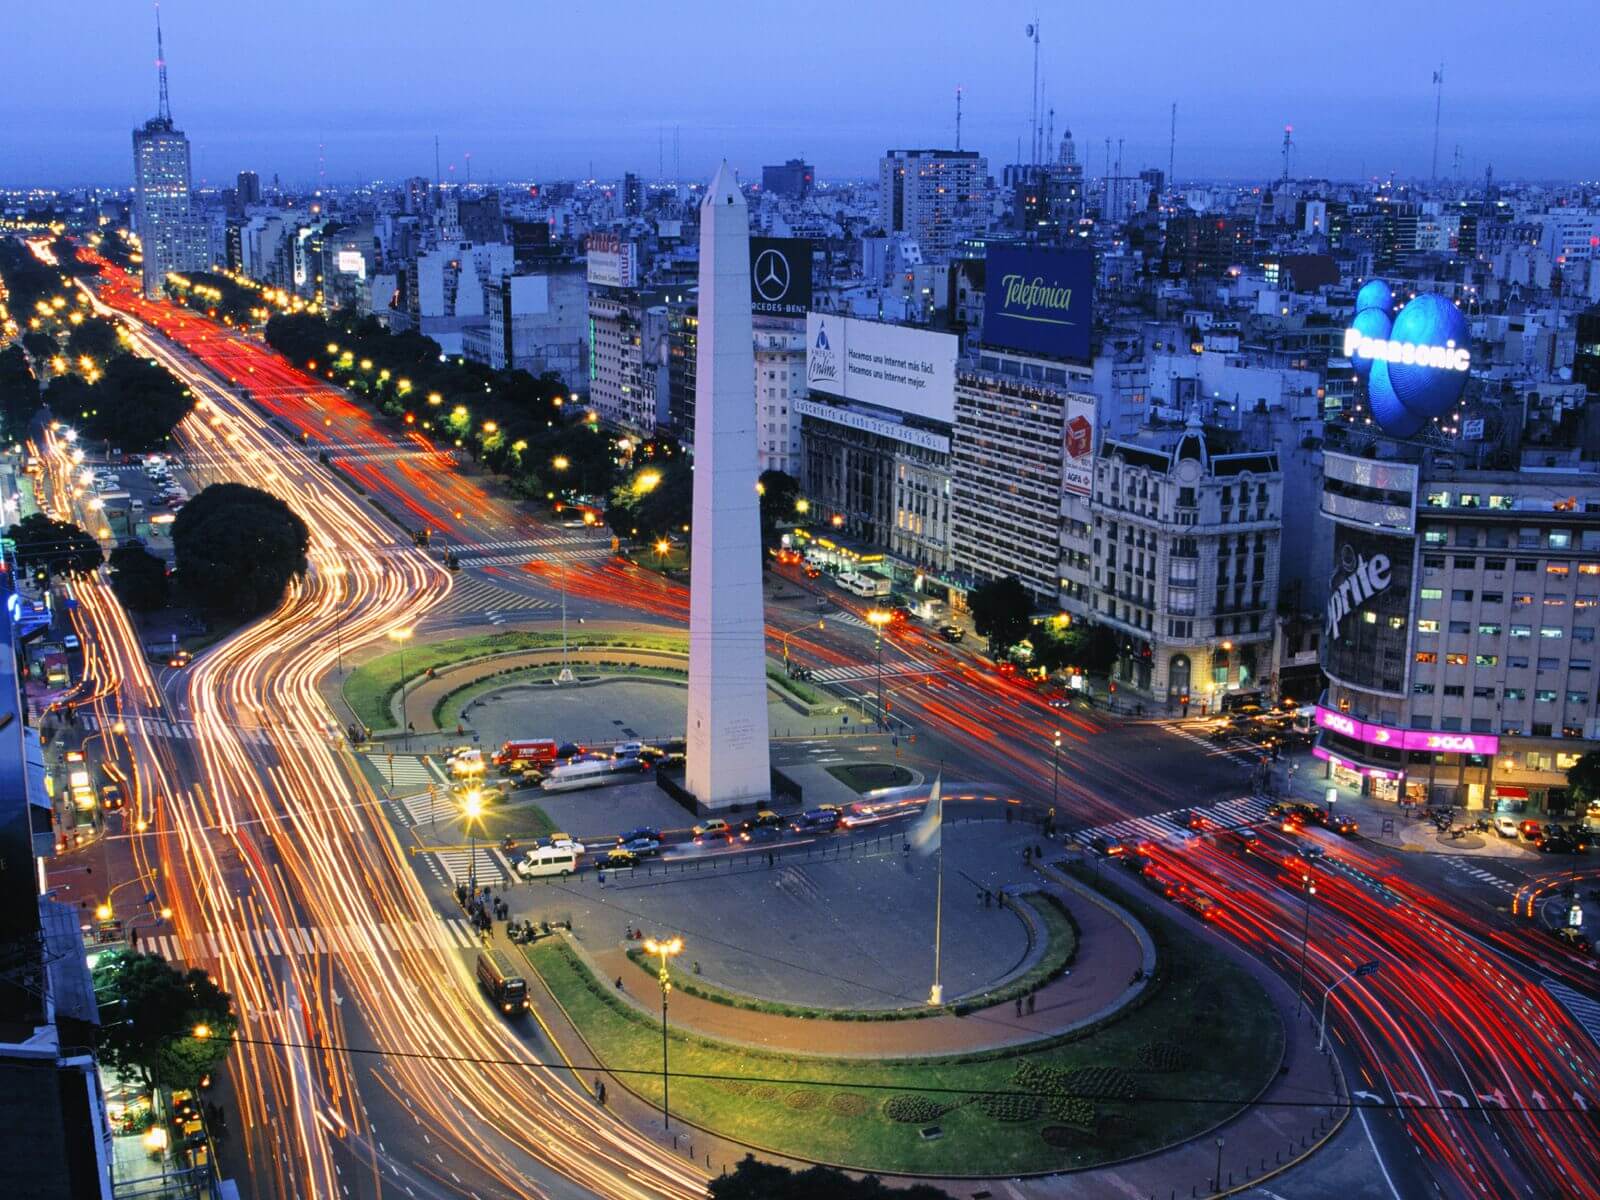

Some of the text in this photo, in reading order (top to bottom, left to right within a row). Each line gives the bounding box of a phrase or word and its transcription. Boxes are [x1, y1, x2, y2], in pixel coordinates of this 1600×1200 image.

[752, 302, 806, 313] RCEDES-BENZ
[848, 348, 872, 362] Hacemos
[873, 355, 883, 364] una
[884, 355, 907, 369] Internet
[1344, 328, 1470, 371] Panasonic
[848, 363, 872, 377] Hacemos
[873, 370, 883, 380] una
[884, 370, 907, 384] Internet
[1325, 552, 1392, 640] prite
